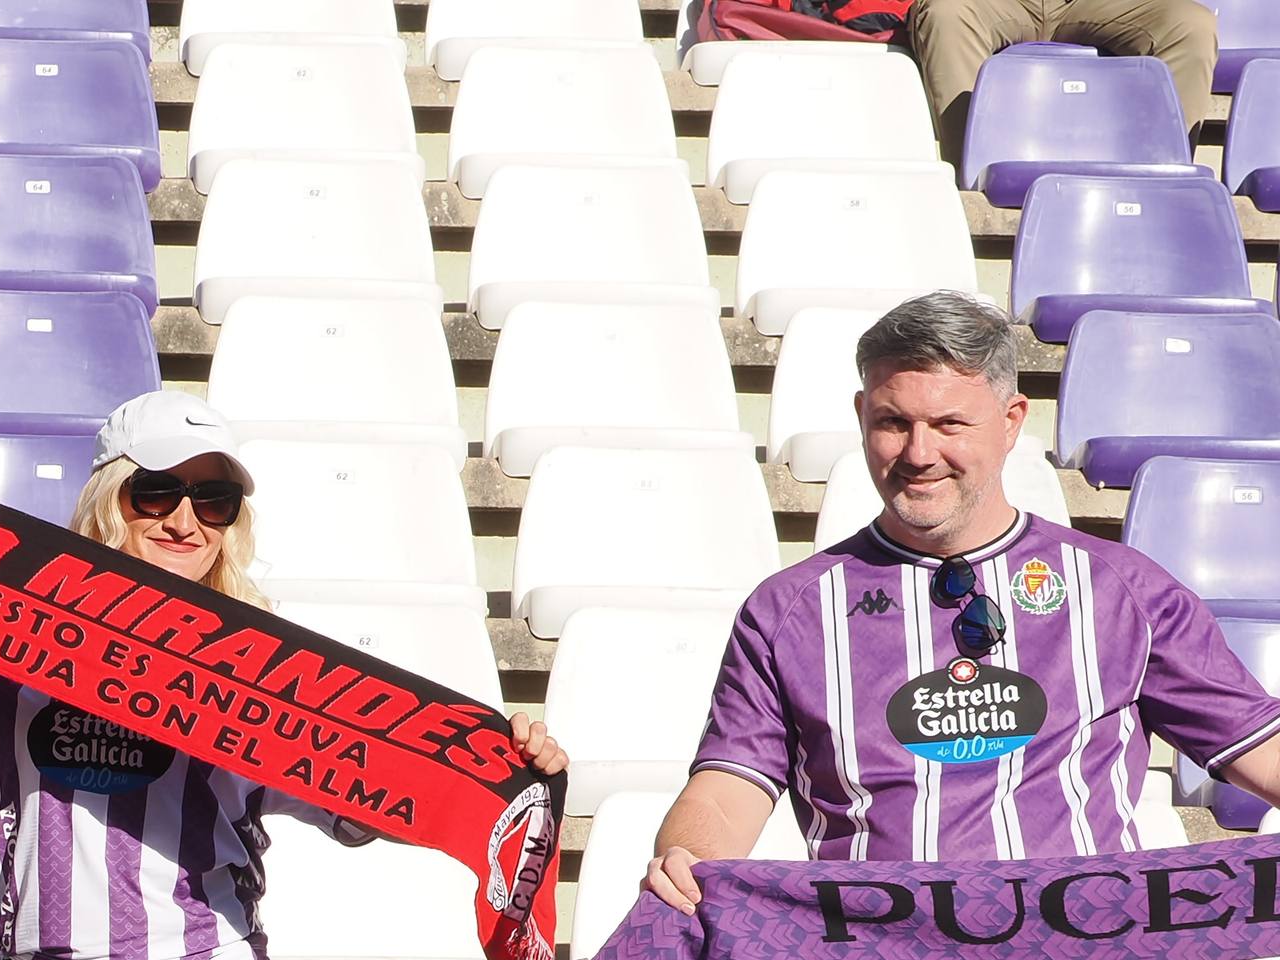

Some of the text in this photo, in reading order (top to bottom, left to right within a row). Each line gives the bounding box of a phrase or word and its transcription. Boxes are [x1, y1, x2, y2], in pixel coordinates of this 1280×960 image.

[359, 637, 371, 645] 62
[23, 553, 527, 784] MIRANDÉS
[100, 639, 152, 678] ES
[166, 670, 369, 770] ANDUVA
[911, 682, 1021, 710] Estrella
[917, 705, 1018, 737] Galicia
[52, 735, 144, 768] Galicia
[96, 677, 199, 737] CON
[213, 726, 264, 767] EL
[283, 757, 416, 827] ALMA
